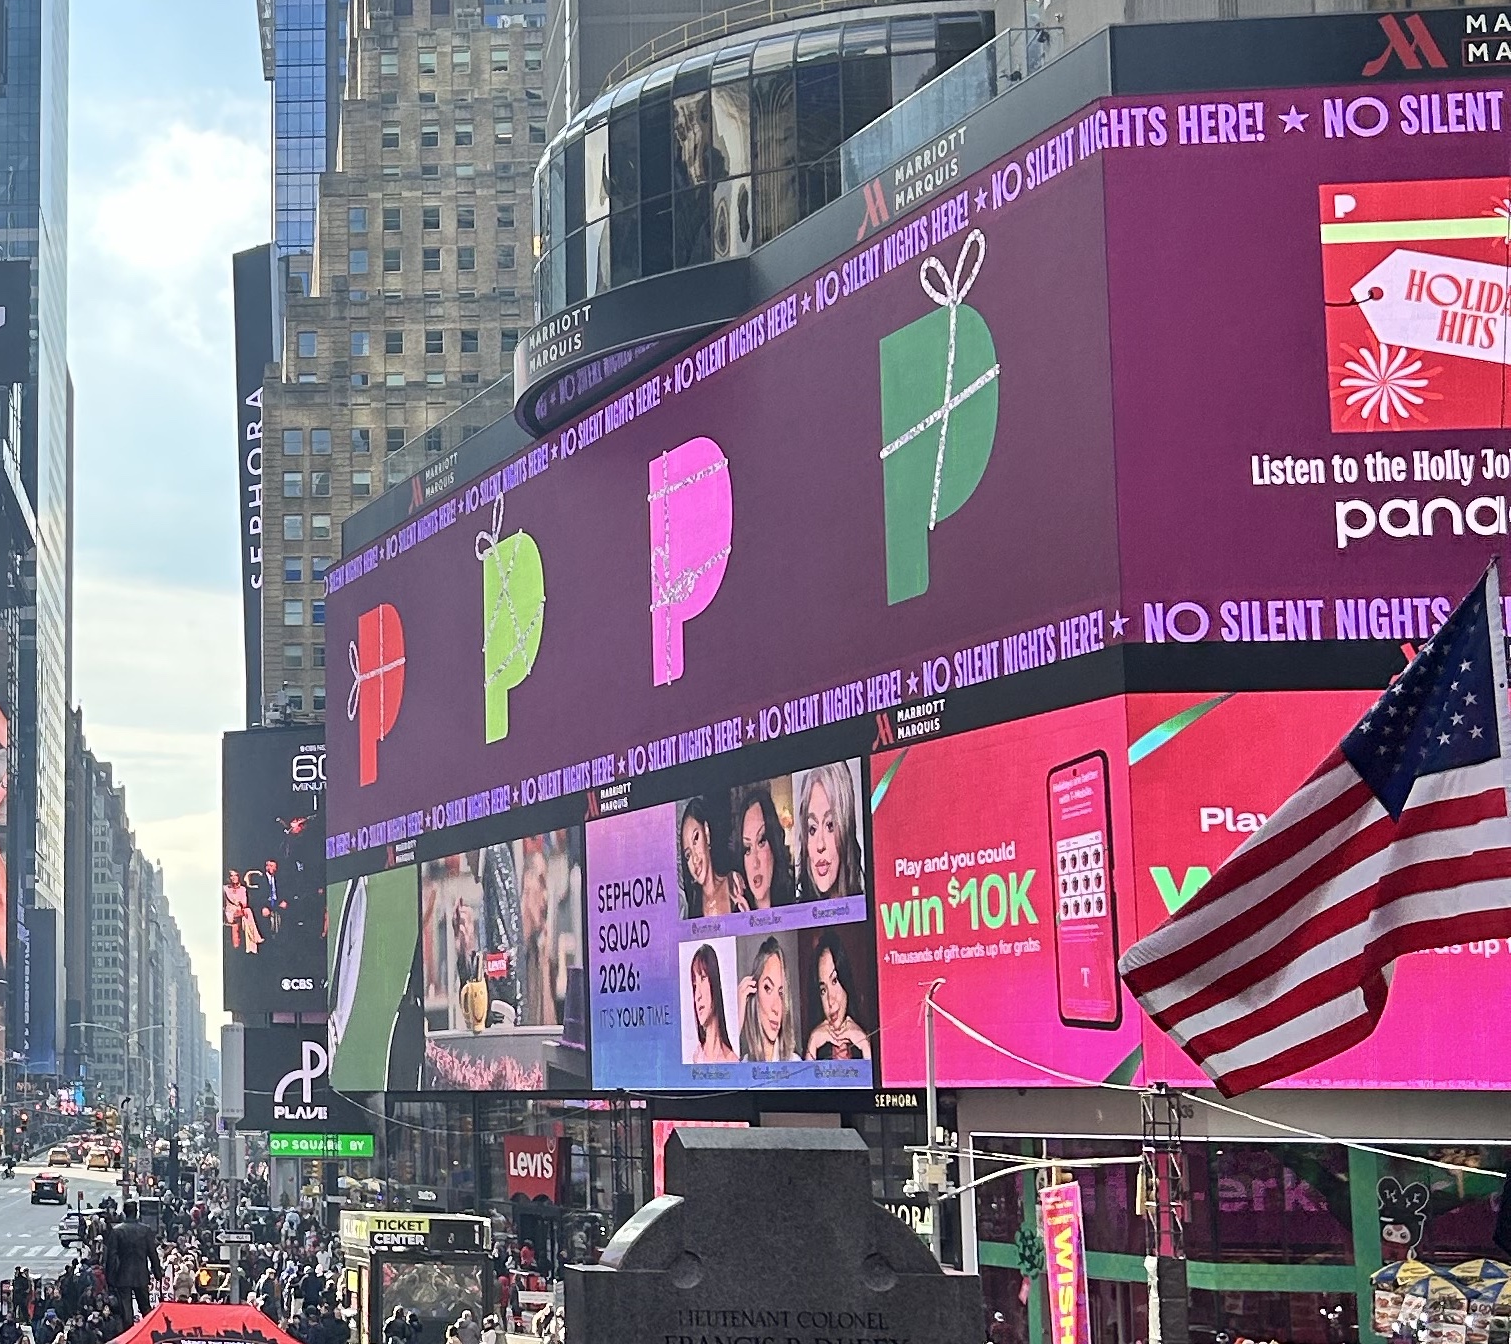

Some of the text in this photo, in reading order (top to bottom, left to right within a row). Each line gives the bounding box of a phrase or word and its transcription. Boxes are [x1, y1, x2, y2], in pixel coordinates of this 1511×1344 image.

[894, 125, 967, 186] MARRIOTT
[992, 101, 1265, 210] NO SILENT NIGHTS HERE!
[895, 157, 959, 211] MARQUIS
[529, 304, 592, 351] MARRIOTT
[1436, 309, 1497, 349] HITS
[529, 332, 582, 375] MARQUIS
[424, 451, 459, 483] MARRIOTT
[1251, 449, 1476, 487] Listen to the Holly
[245, 387, 265, 589] SEPHORA
[425, 471, 455, 499] MARQUIS
[1144, 597, 1451, 643] NO SILENT NIGHTS
[897, 698, 946, 723] MARRIOTT
[897, 717, 941, 740] MARQUIS
[895, 841, 1016, 878] Play and you could
[597, 874, 667, 913] SEPHORA
[880, 869, 1039, 940] win $10K
[598, 919, 651, 954] SQUAD
[933, 945, 944, 962] of
[944, 943, 961, 963] gift
[962, 941, 985, 959] cards
[985, 944, 998, 959] up
[999, 939, 1012, 956] for
[1014, 937, 1041, 955] grabs
[291, 978, 313, 991] CBS
[599, 962, 641, 994] 2026:
[617, 1006, 646, 1027] YOUR
[874, 1093, 918, 1107] SEPHORA
[350, 1139, 365, 1152] BY
[373, 1233, 426, 1247] CENTER
[374, 1218, 425, 1232] TICKET
[678, 1309, 890, 1330] LIEUTENANT COLONEL
